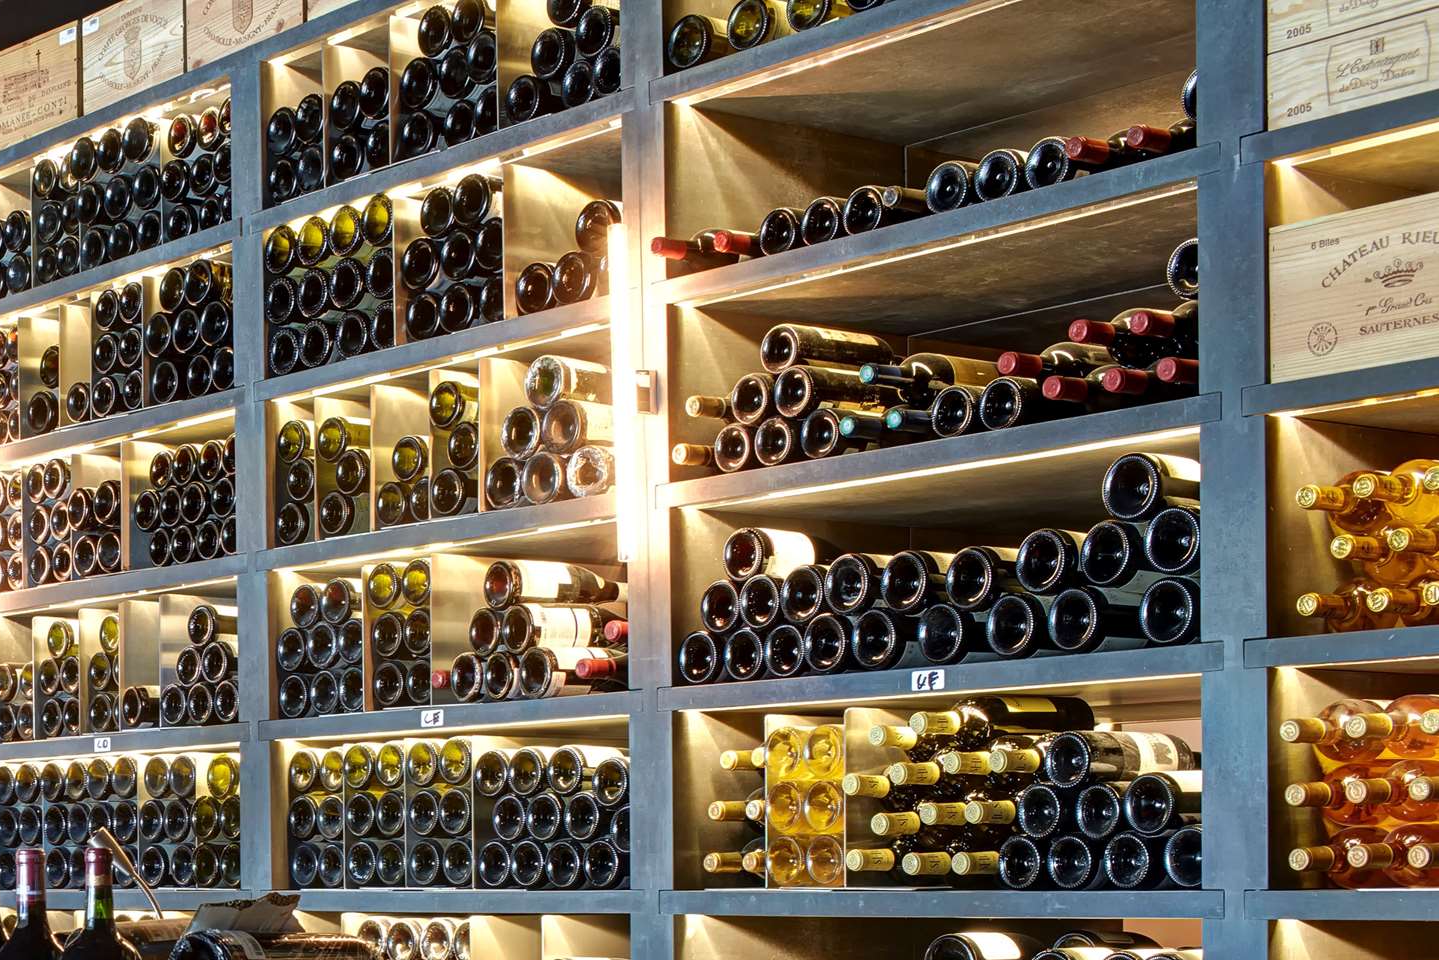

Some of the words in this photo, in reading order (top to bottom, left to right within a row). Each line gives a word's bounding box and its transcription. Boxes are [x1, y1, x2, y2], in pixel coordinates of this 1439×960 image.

[1286, 23, 1312, 39] 2005
[1287, 102, 1312, 118] 2005
[1321, 235, 1390, 288] CHATEAU
[1359, 313, 1439, 336] SAUTERNES
